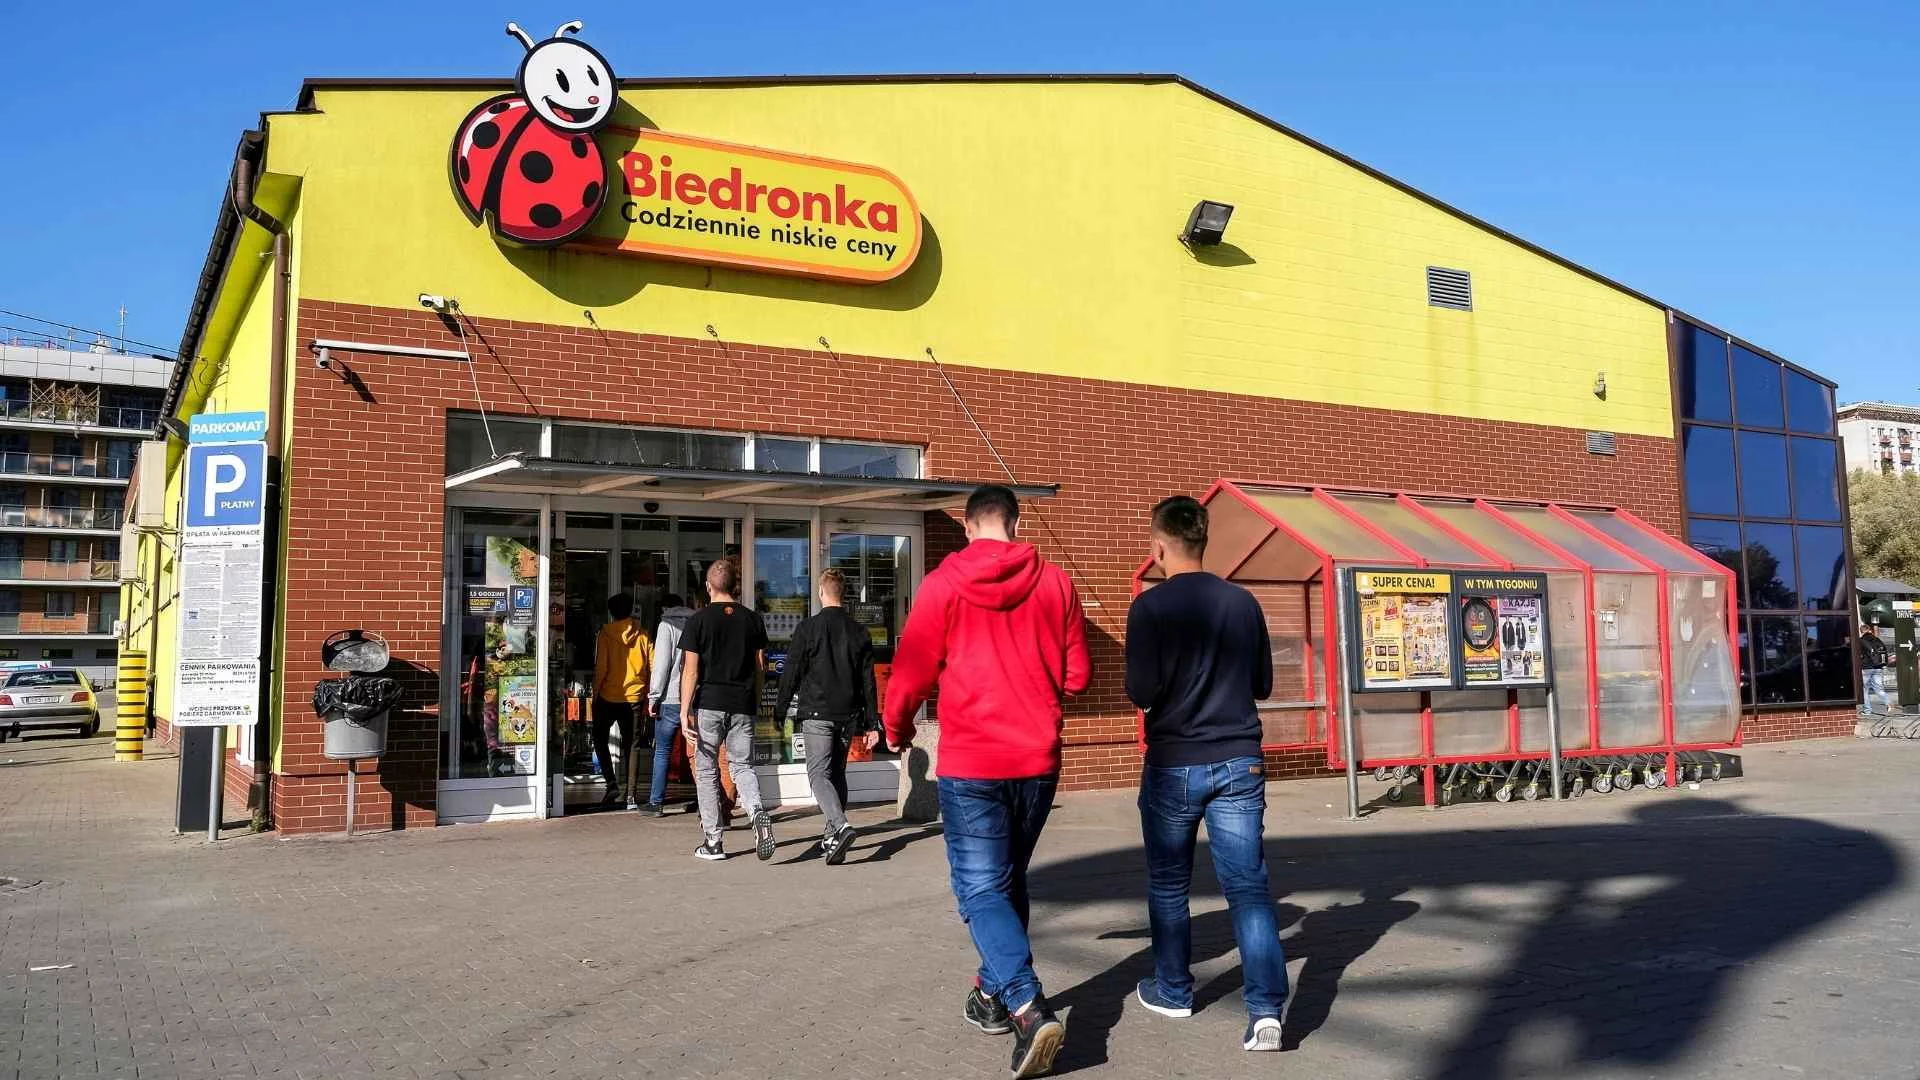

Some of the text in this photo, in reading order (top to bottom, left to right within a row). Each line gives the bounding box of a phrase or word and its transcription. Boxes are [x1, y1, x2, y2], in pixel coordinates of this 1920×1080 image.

[624, 151, 898, 233] Biedronka
[621, 201, 897, 261] Codziennie niskie ceny
[191, 421, 263, 434] PARKOMAT
[204, 454, 247, 517] P
[220, 500, 256, 509] PŁATNY
[1372, 576, 1435, 588] SUPER CENA!
[1464, 579, 1538, 589] W TYM TYGODNIU
[1896, 610, 1912, 618] DRIVE
